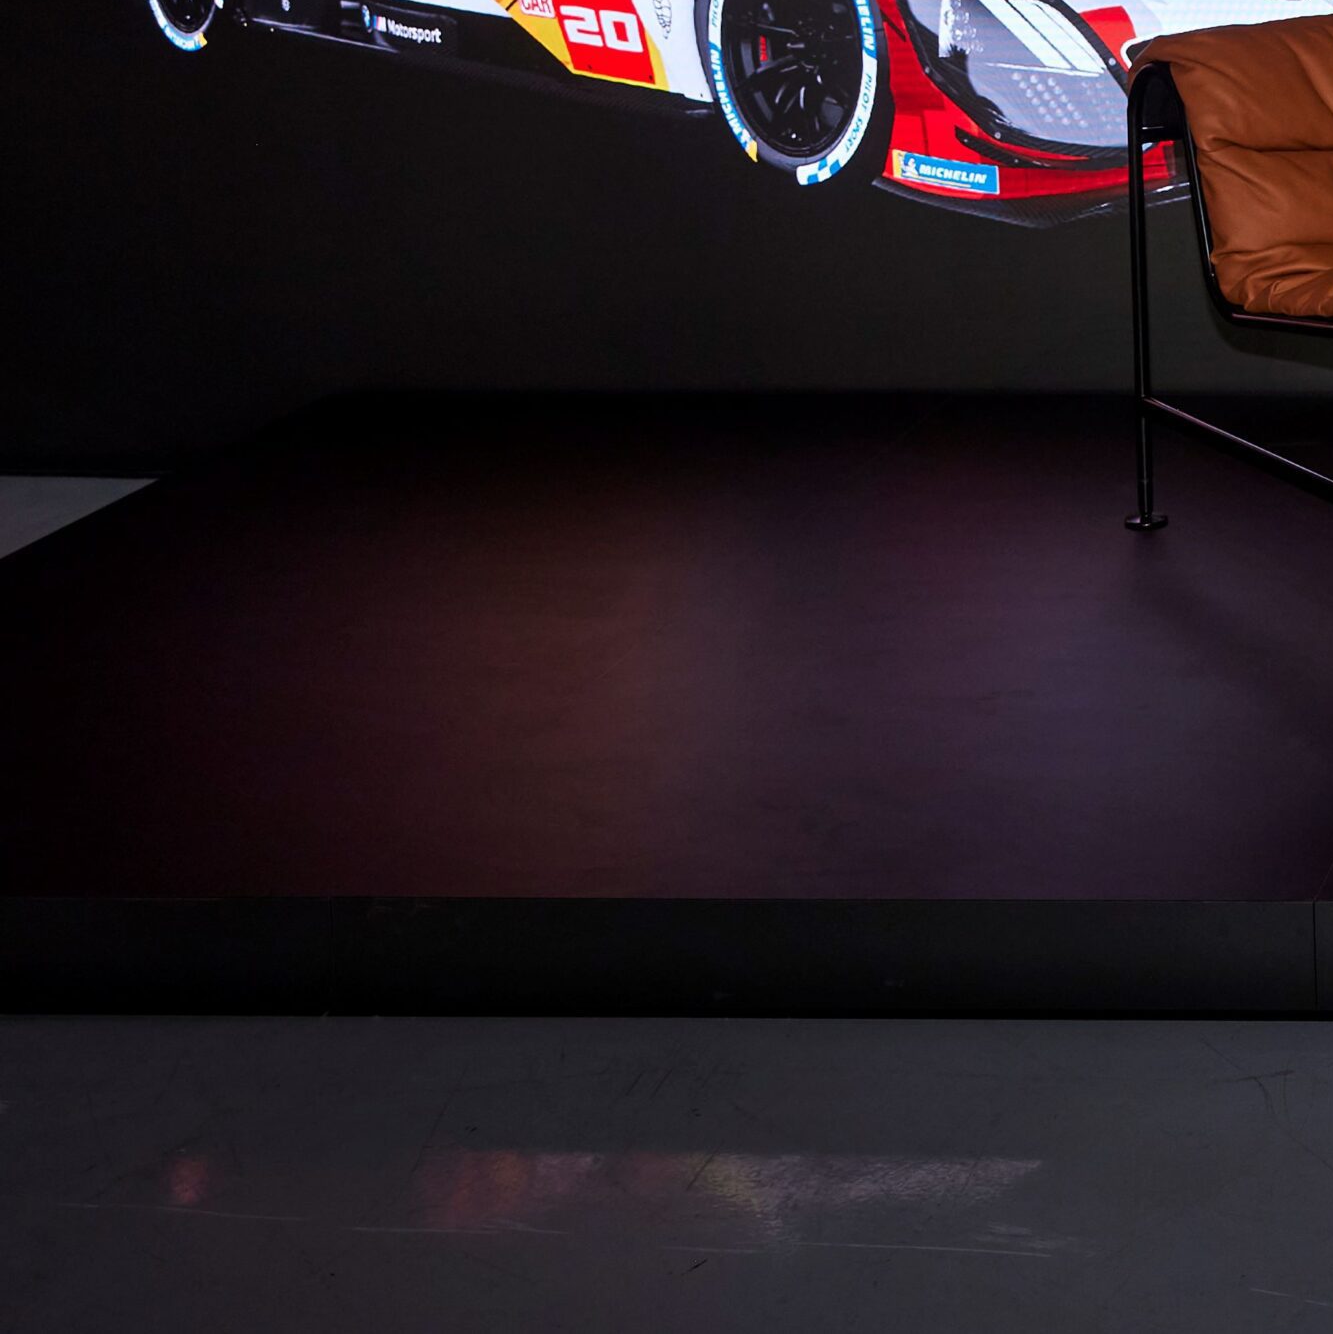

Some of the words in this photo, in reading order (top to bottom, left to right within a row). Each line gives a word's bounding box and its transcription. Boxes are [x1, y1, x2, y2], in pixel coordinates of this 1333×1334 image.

[387, 19, 442, 44] Motorsport
[560, 5, 644, 53] 20
[709, 48, 741, 133] MICHELIN
[918, 164, 988, 185] MICHELIN
